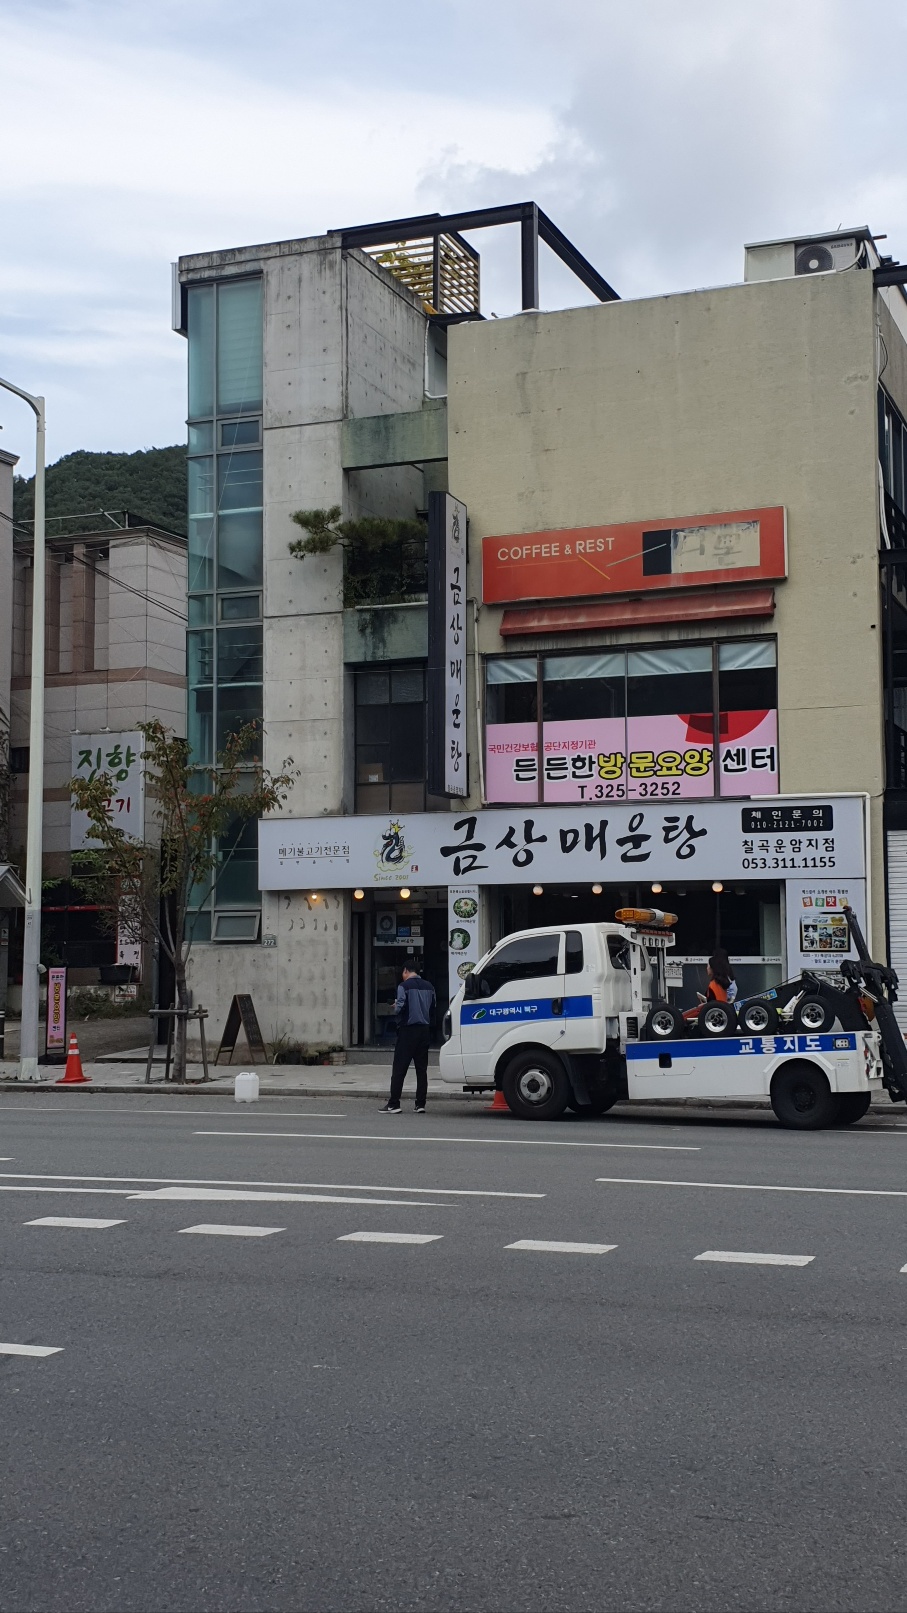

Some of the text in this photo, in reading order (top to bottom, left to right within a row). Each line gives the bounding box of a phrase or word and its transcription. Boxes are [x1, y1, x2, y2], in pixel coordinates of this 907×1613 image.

[497, 537, 615, 561] COFFEE & REST
[544, 739, 597, 752] 공단지정기관
[577, 781, 682, 800] T.325-3252
[741, 838, 836, 854] 칠곡운암지점
[741, 856, 836, 869] 053.311.1155
[739, 1035, 822, 1054] 교통지도
